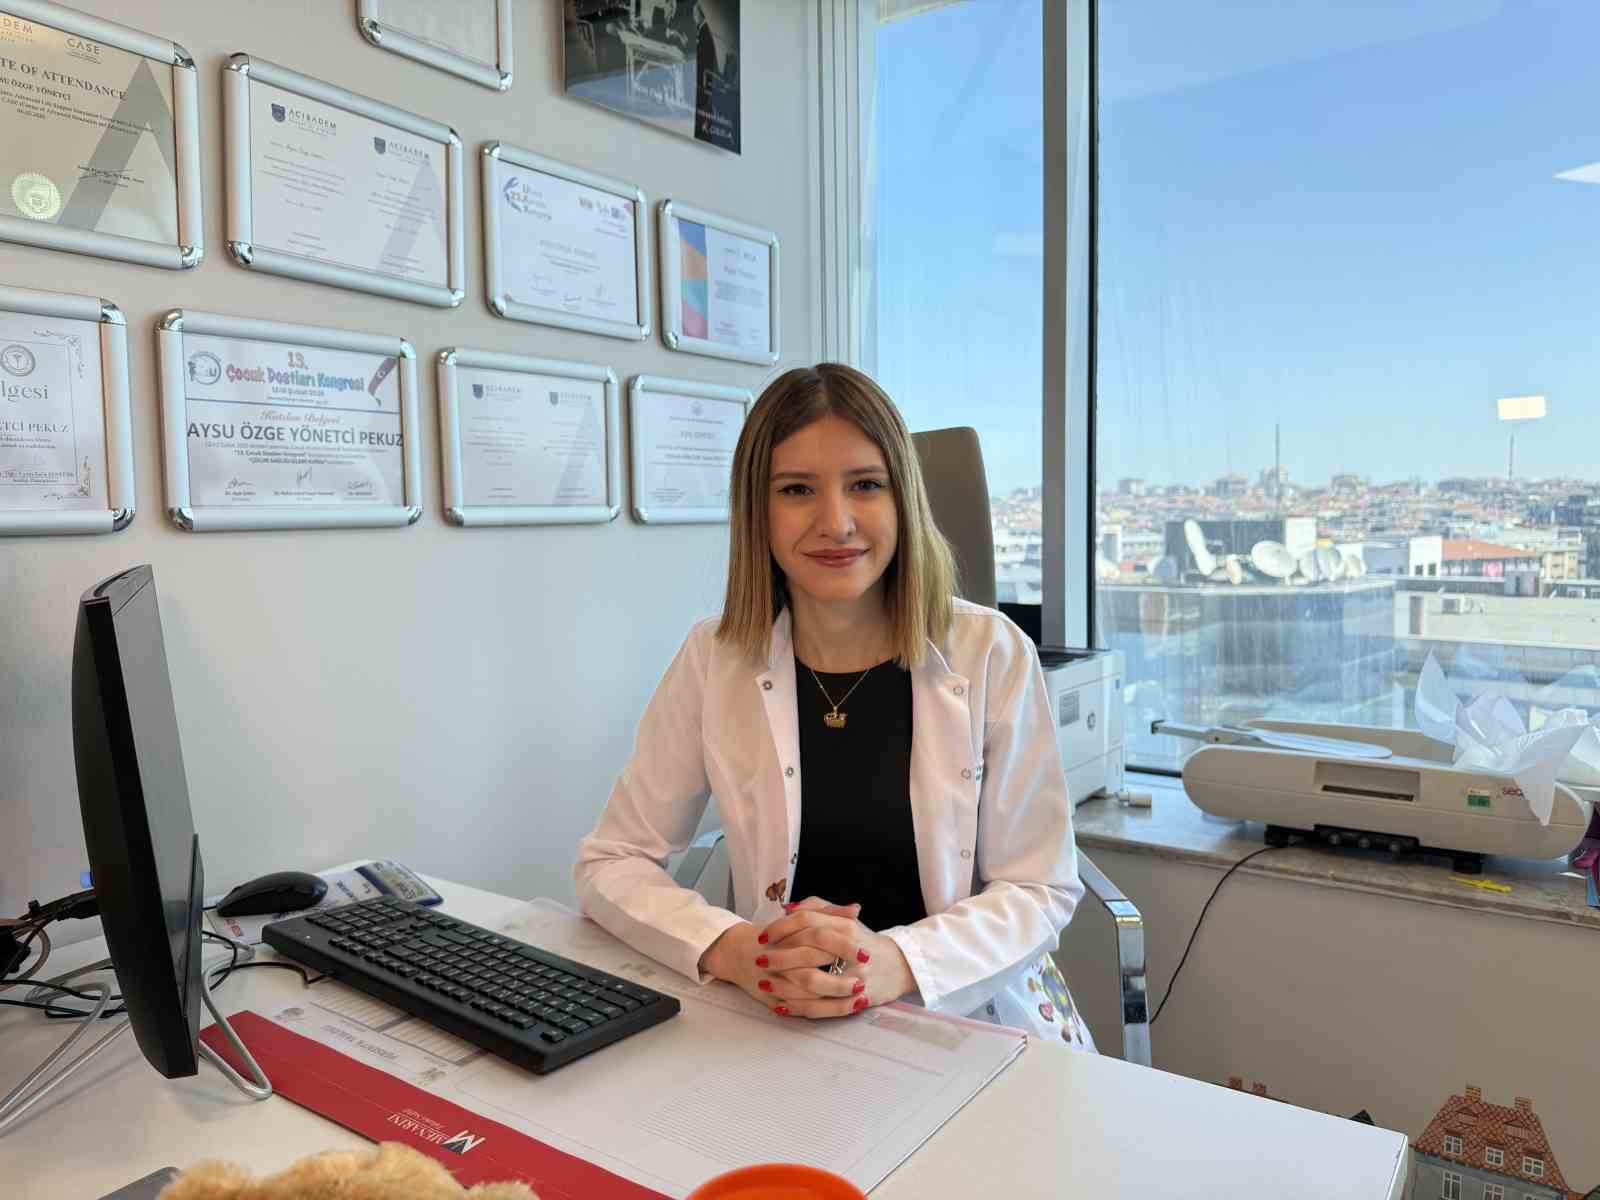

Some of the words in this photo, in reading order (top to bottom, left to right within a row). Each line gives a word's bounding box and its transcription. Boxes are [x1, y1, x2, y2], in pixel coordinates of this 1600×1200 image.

[66, 38, 100, 55] CASE
[20, 63, 38, 76] OF
[42, 71, 127, 100] ATTENDANCE
[287, 351, 309, 369] 13.
[226, 363, 265, 383] Çocuk
[267, 367, 316, 386] Dostları
[318, 373, 364, 392] Kongresi
[1, 380, 48, 402] lgesi
[187, 423, 235, 439] AYSU
[240, 421, 285, 441] ÖZGE
[289, 425, 355, 445] YÖNETCİ
[359, 432, 404, 447] PEKUZ
